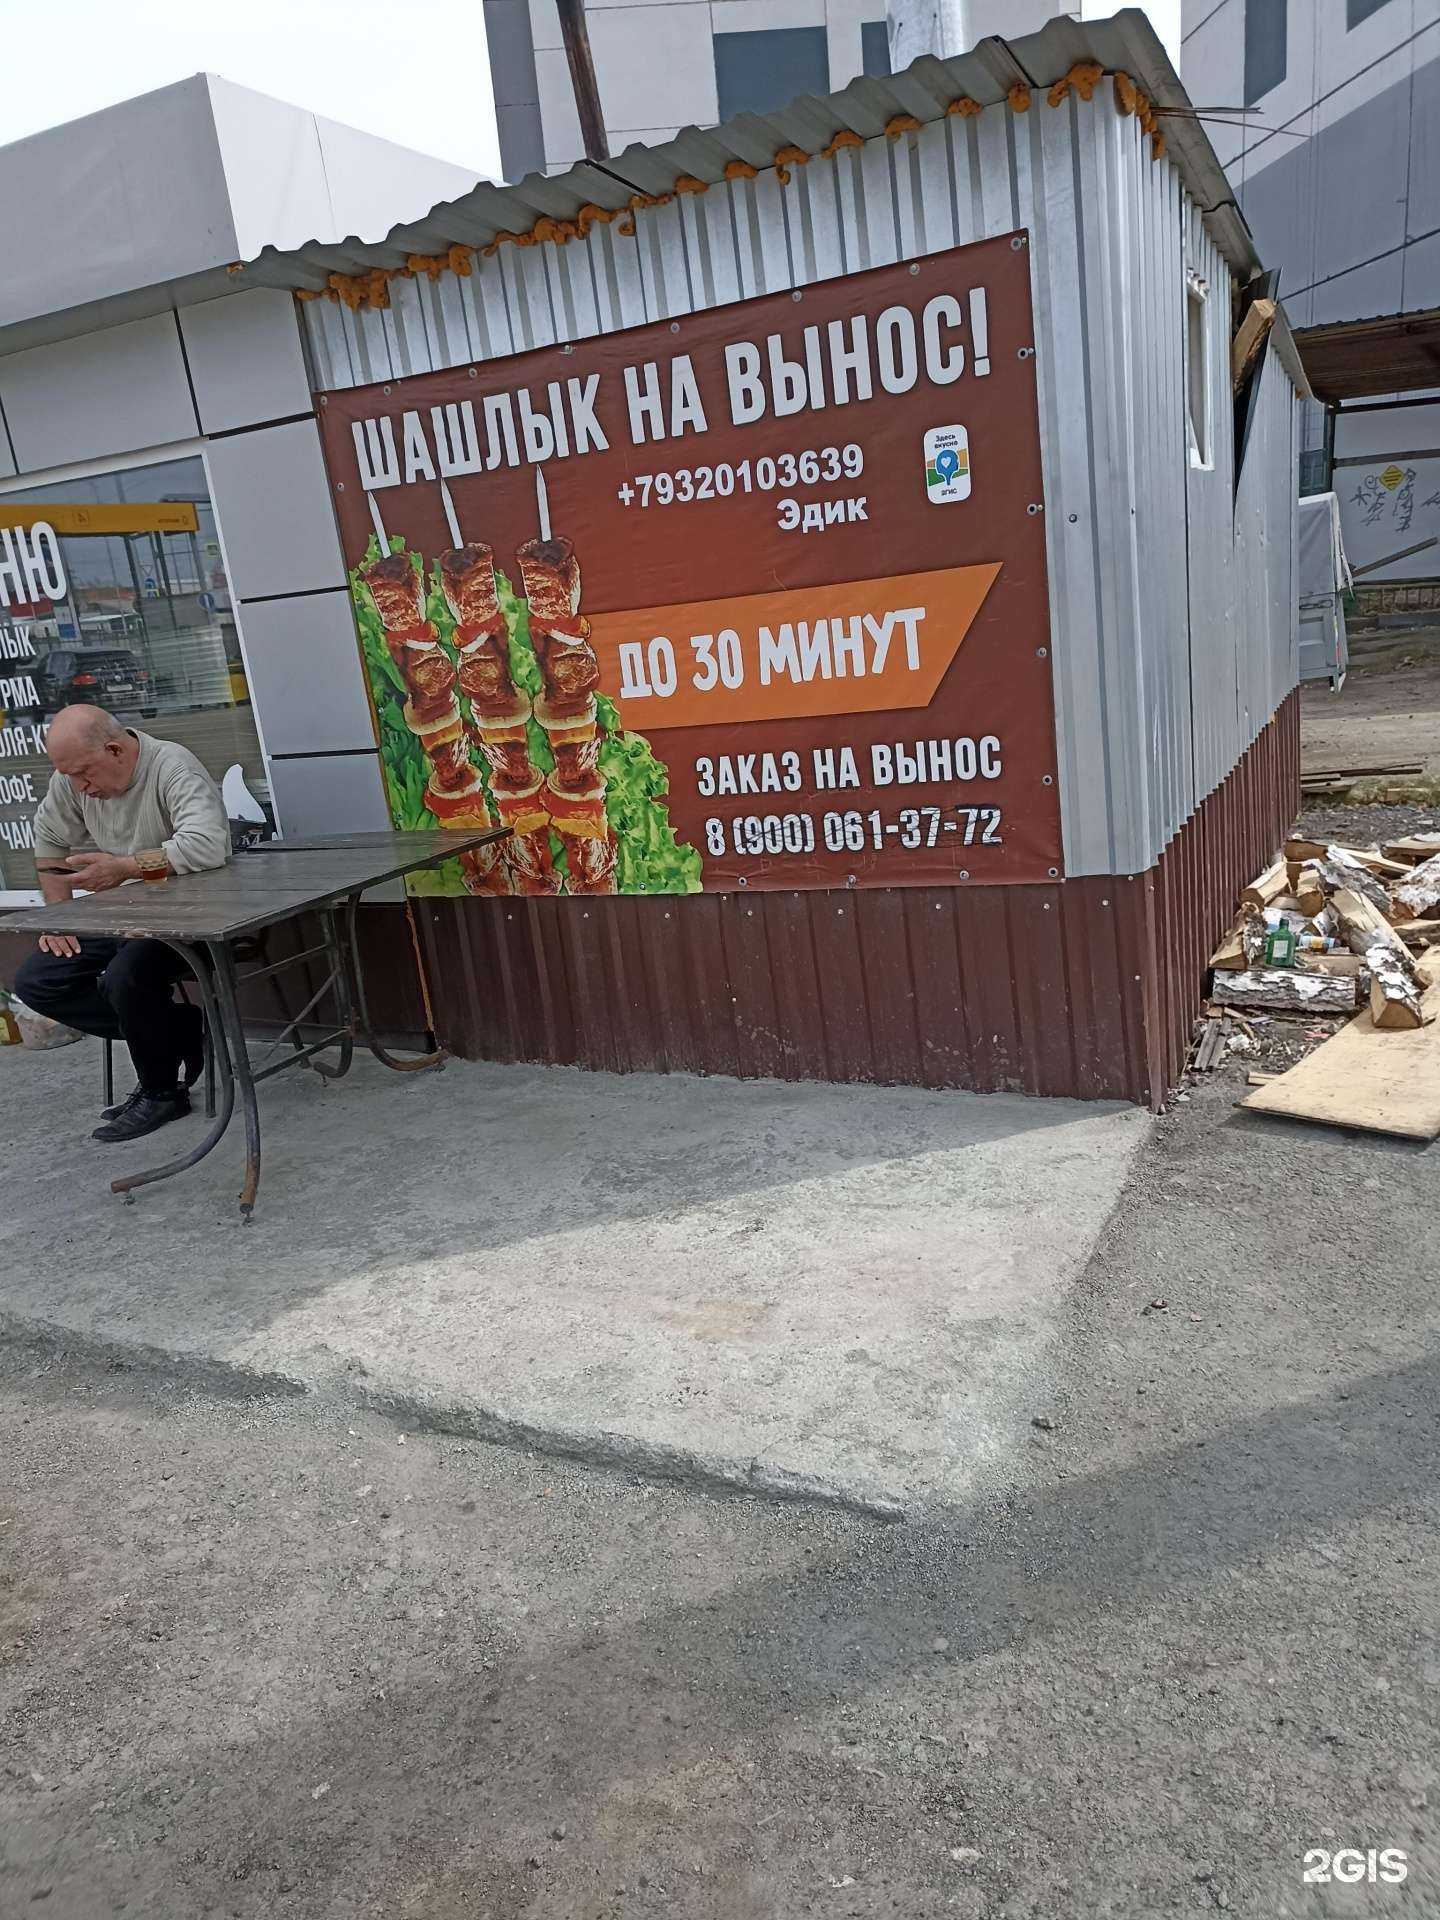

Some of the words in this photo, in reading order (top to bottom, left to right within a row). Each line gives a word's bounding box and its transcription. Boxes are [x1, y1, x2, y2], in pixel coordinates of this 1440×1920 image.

[351, 373, 609, 491] ШАШЛЫК
[623, 354, 708, 445] НА
[724, 287, 991, 426] ВЫНОС!
[617, 443, 864, 507] +79320103639
[776, 497, 869, 533] Эдик
[618, 636, 678, 699] ДО
[689, 629, 745, 691] 30
[758, 606, 926, 686] МИНУТ
[696, 751, 802, 796] ЗАКАЗ
[812, 747, 861, 789] НА
[871, 735, 1002, 786] ВЫНОС
[705, 817, 726, 857] 8
[732, 813, 815, 855] (900)
[823, 806, 1003, 852] 061-37-72
